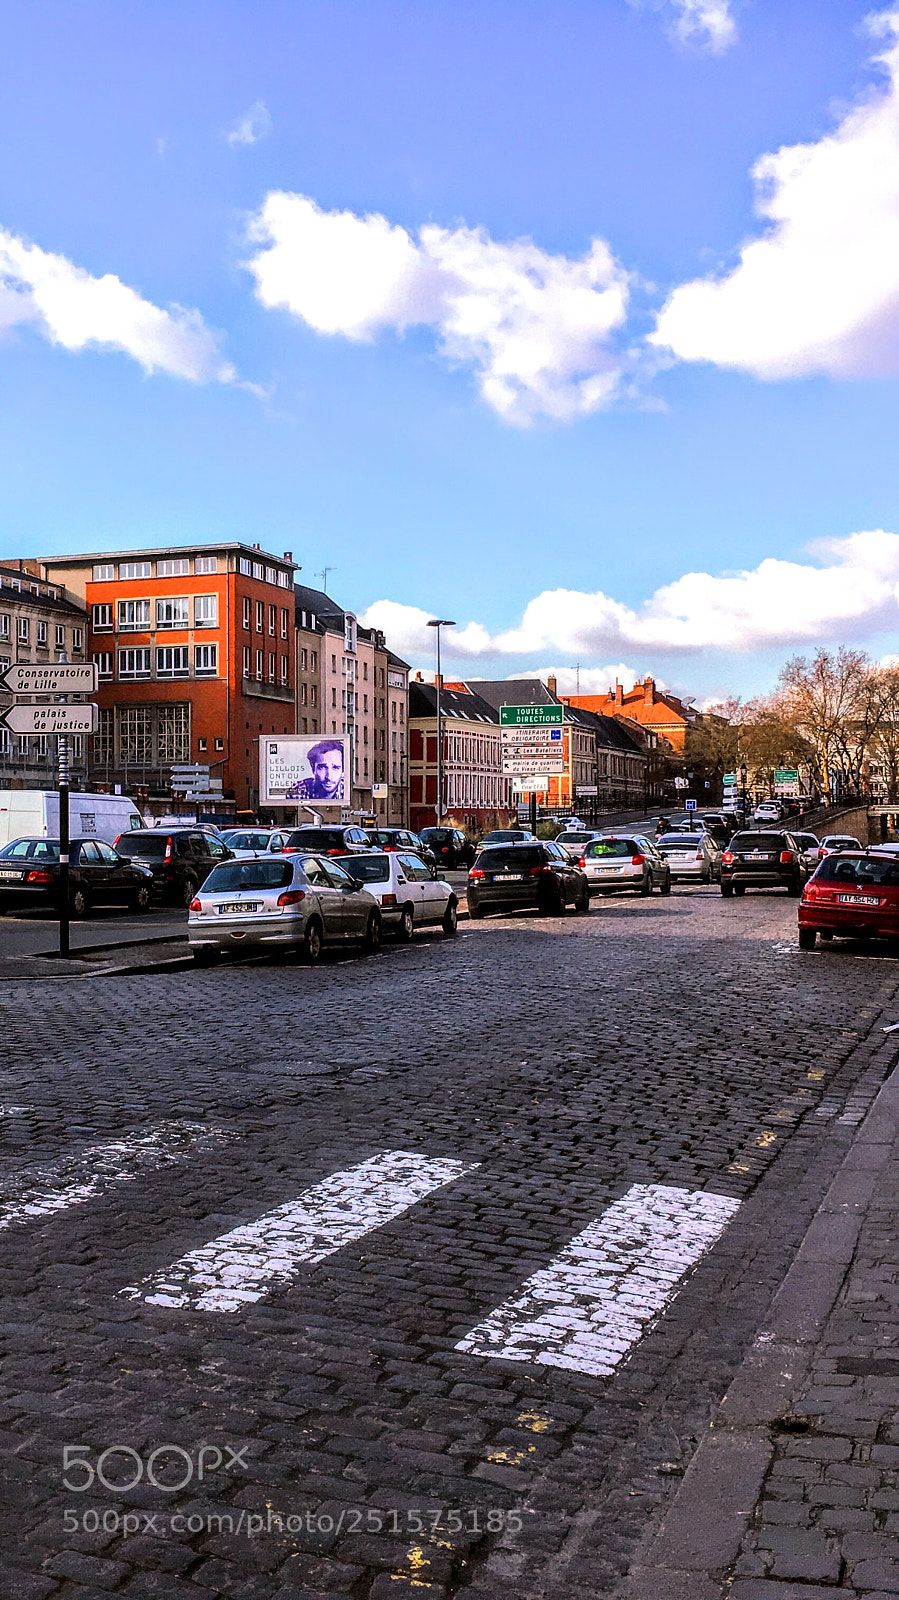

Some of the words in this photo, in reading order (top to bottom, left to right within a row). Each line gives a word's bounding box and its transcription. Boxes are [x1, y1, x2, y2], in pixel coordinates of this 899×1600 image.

[17, 668, 91, 678] Conservatoire
[17, 681, 29, 689] de
[34, 680, 58, 689] Lille
[33, 708, 67, 720] palais
[516, 715, 561, 723] DIRECTIONS
[34, 720, 46, 730] de
[52, 720, 90, 731] justice
